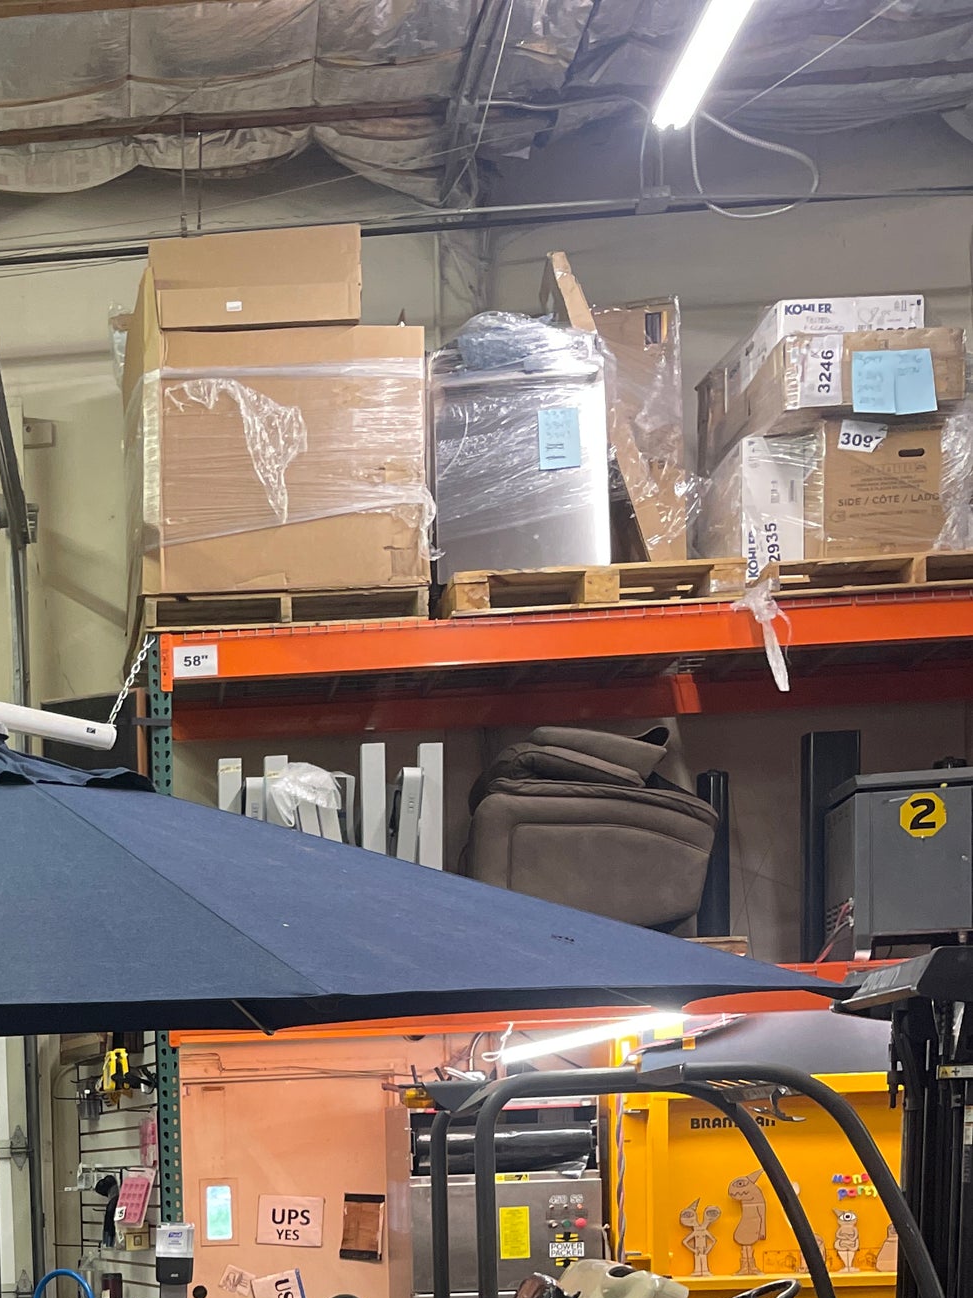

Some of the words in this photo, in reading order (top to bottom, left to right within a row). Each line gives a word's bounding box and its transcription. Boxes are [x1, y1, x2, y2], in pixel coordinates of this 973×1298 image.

[817, 349, 835, 394] 3246
[838, 498, 861, 507] SIDE
[764, 522, 781, 562] 2935
[183, 654, 209, 667] 58"
[909, 798, 936, 830] 2
[271, 1208, 311, 1226] UPS
[276, 1228, 300, 1241] YES
